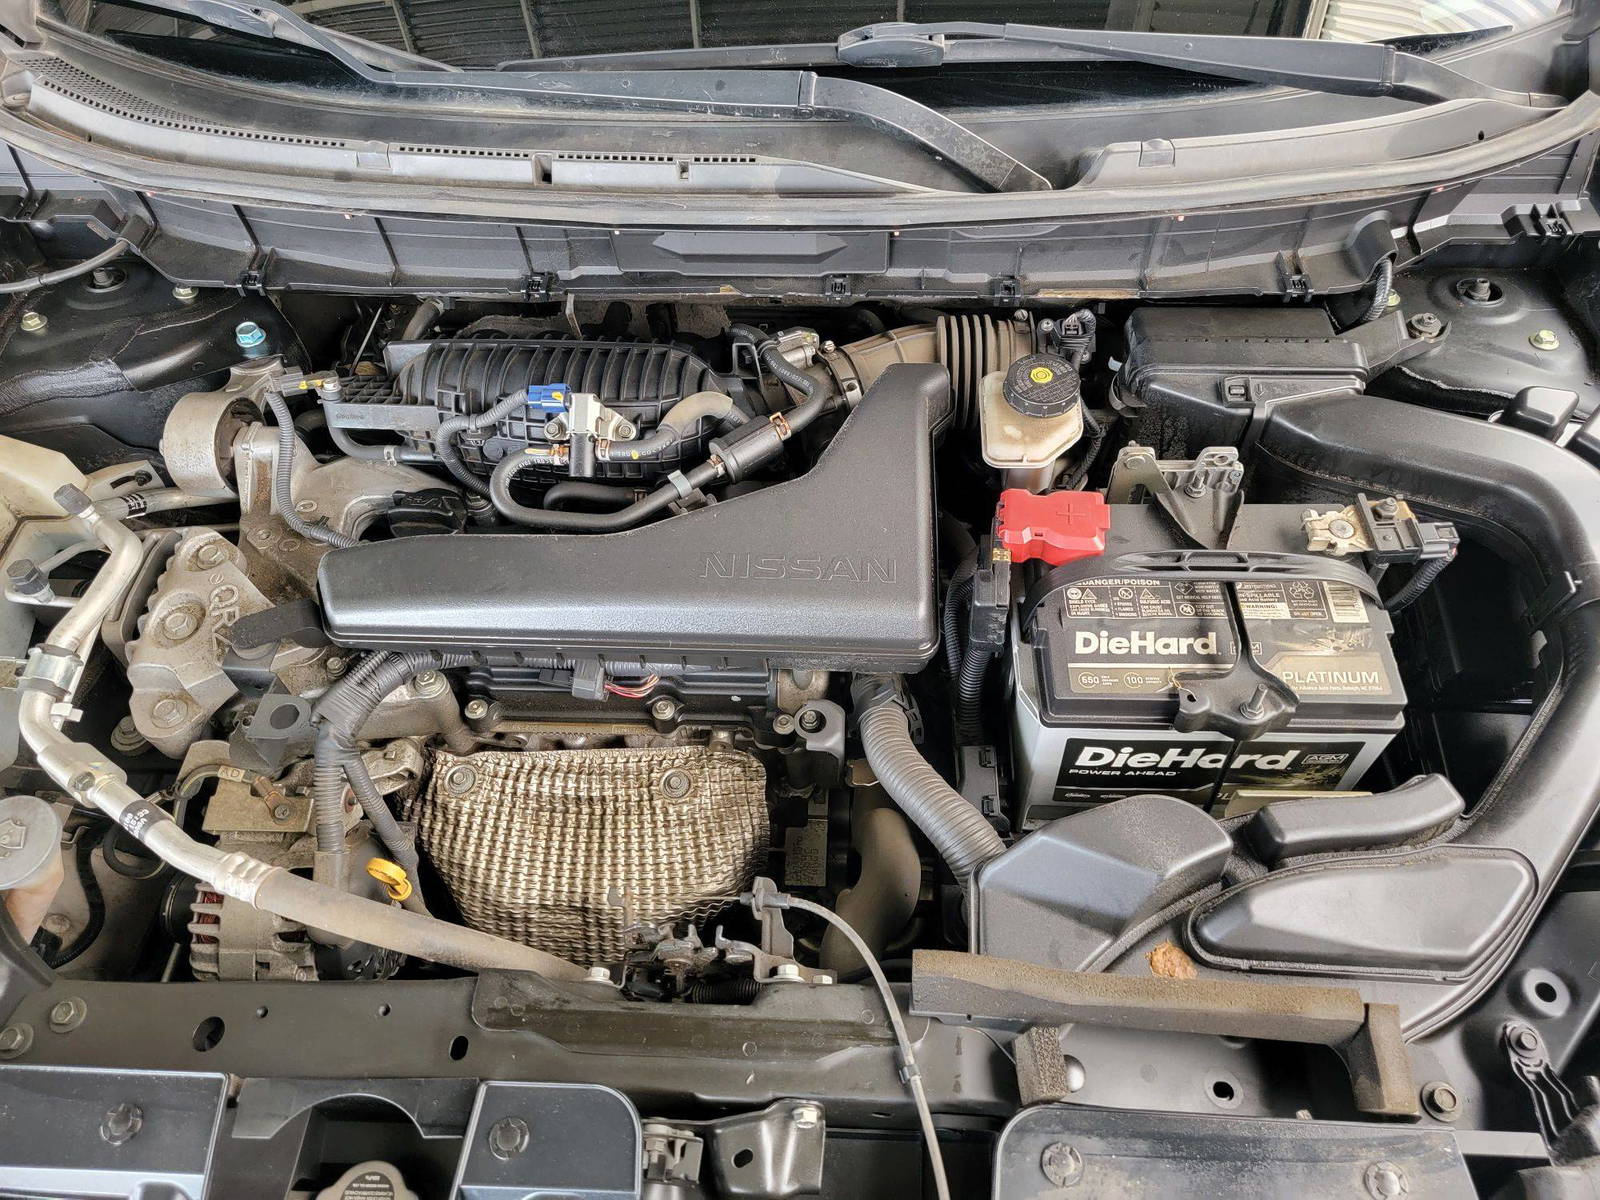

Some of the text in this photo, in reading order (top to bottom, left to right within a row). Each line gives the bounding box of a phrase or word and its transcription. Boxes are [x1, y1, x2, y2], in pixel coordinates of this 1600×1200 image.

[700, 551, 897, 583] NISSAN
[1075, 631, 1217, 655] DieHard
[1126, 676, 1143, 684] 100
[1282, 671, 1380, 684] PLATINUM
[1075, 747, 1301, 770] DieHard
